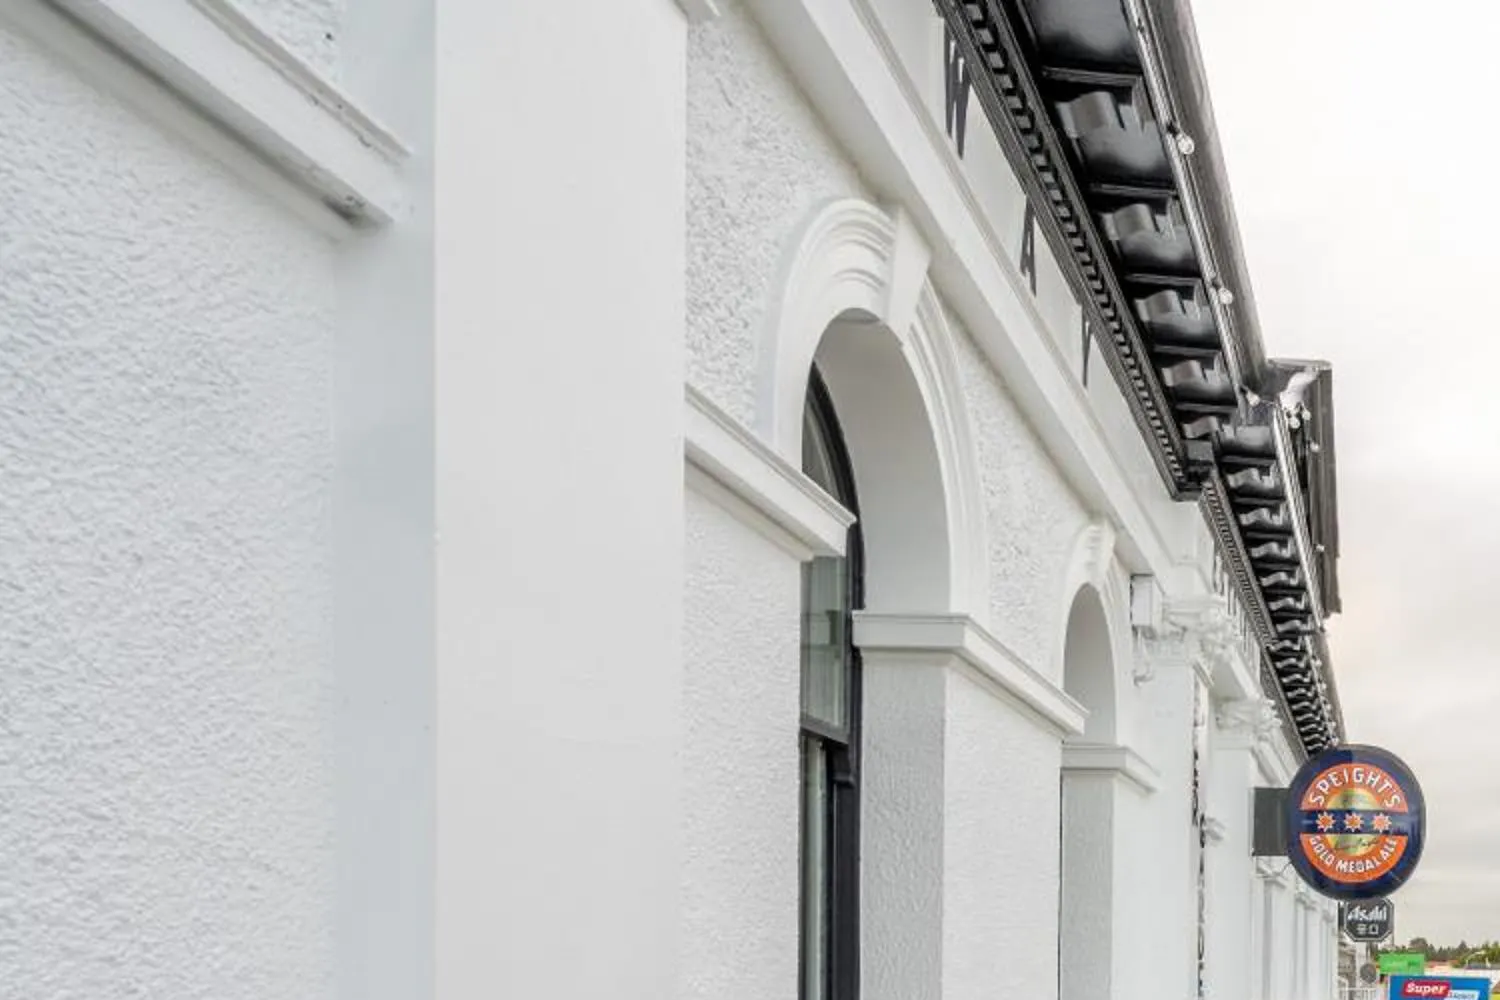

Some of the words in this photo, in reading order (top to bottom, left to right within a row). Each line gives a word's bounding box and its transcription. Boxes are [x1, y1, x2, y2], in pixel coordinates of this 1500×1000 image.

[1309, 767, 1401, 808] SPEIGHT'S
[1308, 835, 1335, 866] GOLD
[1335, 858, 1381, 874] MEDAL
[1347, 905, 1387, 921] Asahi
[1405, 982, 1448, 997] Super
